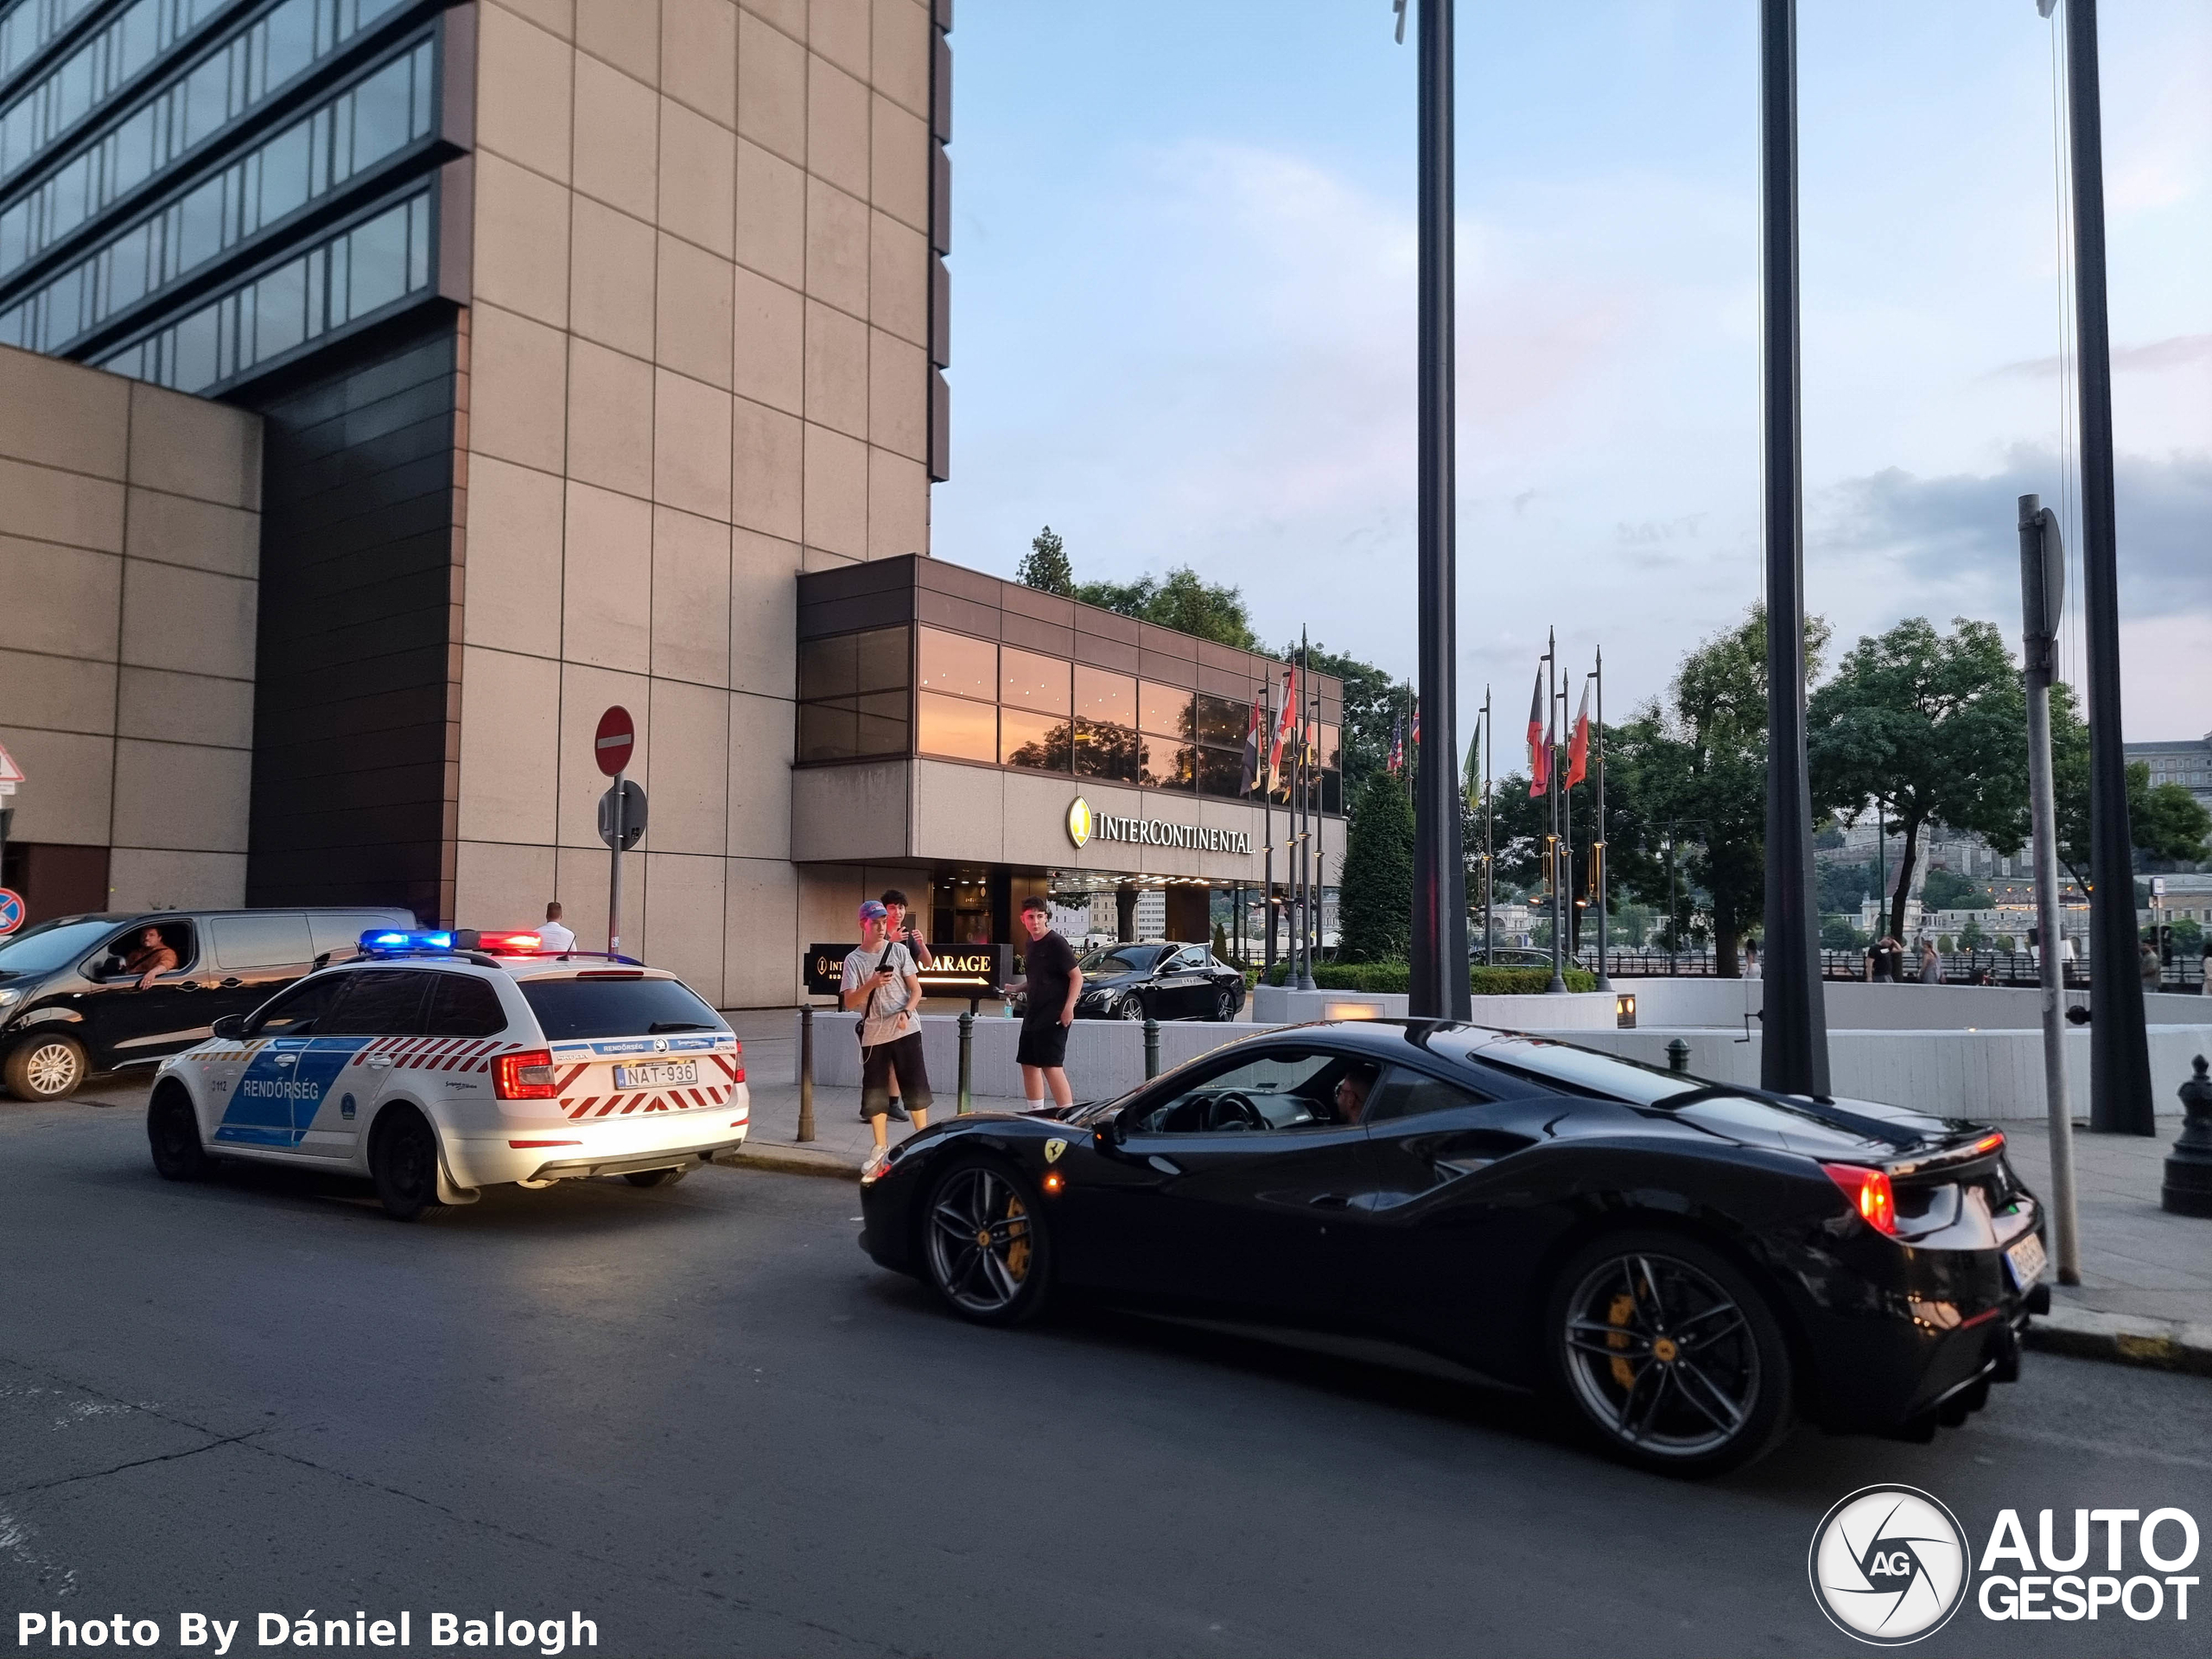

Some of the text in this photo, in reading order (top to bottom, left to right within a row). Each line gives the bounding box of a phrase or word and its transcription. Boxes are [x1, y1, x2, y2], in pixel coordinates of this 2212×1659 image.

[603, 1043, 645, 1052] RENDŐRSÉG
[627, 1065, 693, 1084] NAT-936
[216, 1080, 227, 1092] 112
[244, 1077, 319, 1100] RENDŐRSÉG
